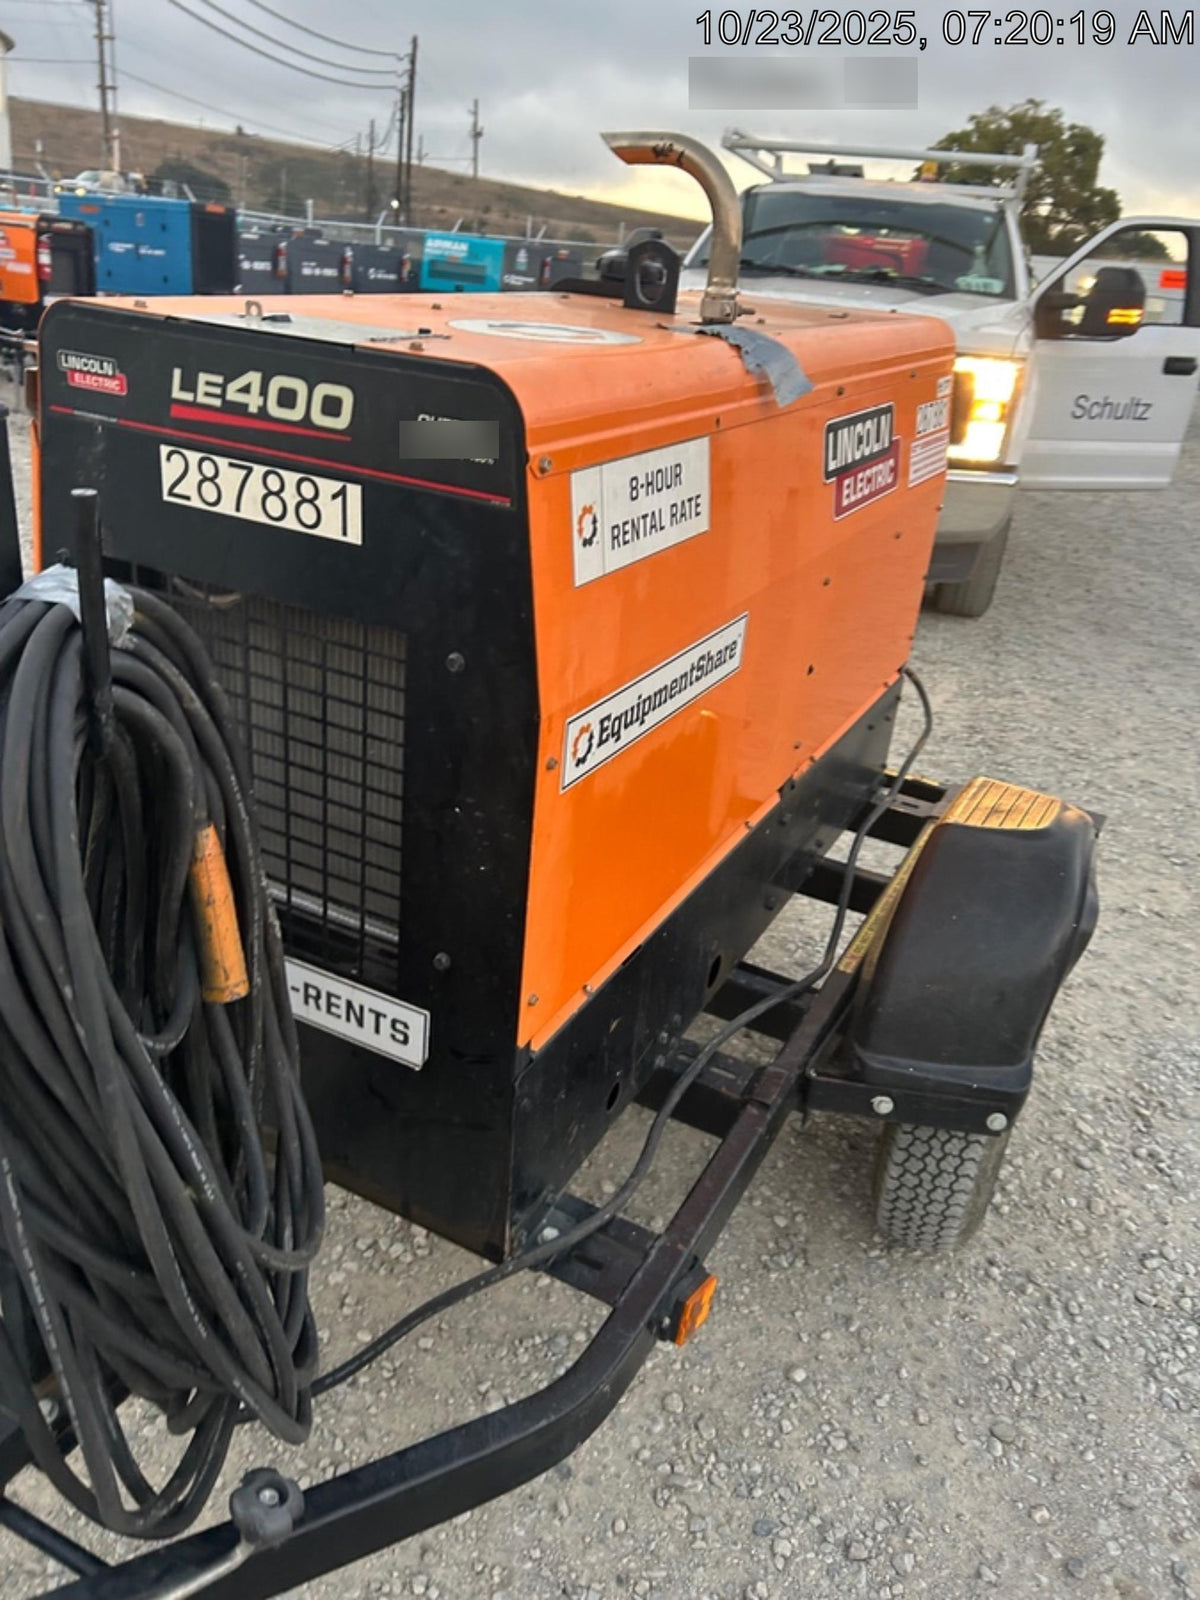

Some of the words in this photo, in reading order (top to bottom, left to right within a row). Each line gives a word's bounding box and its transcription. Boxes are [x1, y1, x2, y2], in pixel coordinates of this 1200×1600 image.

[60, 353, 113, 376] LINCOLN
[74, 372, 121, 391] ELECTRIC
[171, 367, 354, 430] LE400
[1071, 394, 1153, 420] Schultz
[827, 412, 892, 472] LINCOLN
[166, 450, 348, 537] 287881
[629, 463, 682, 502] 8-HOUR
[841, 458, 895, 507] ELECTRIC
[611, 508, 666, 551] RENTAL
[669, 494, 702, 527] RATE
[596, 640, 738, 749] EquipmentShare
